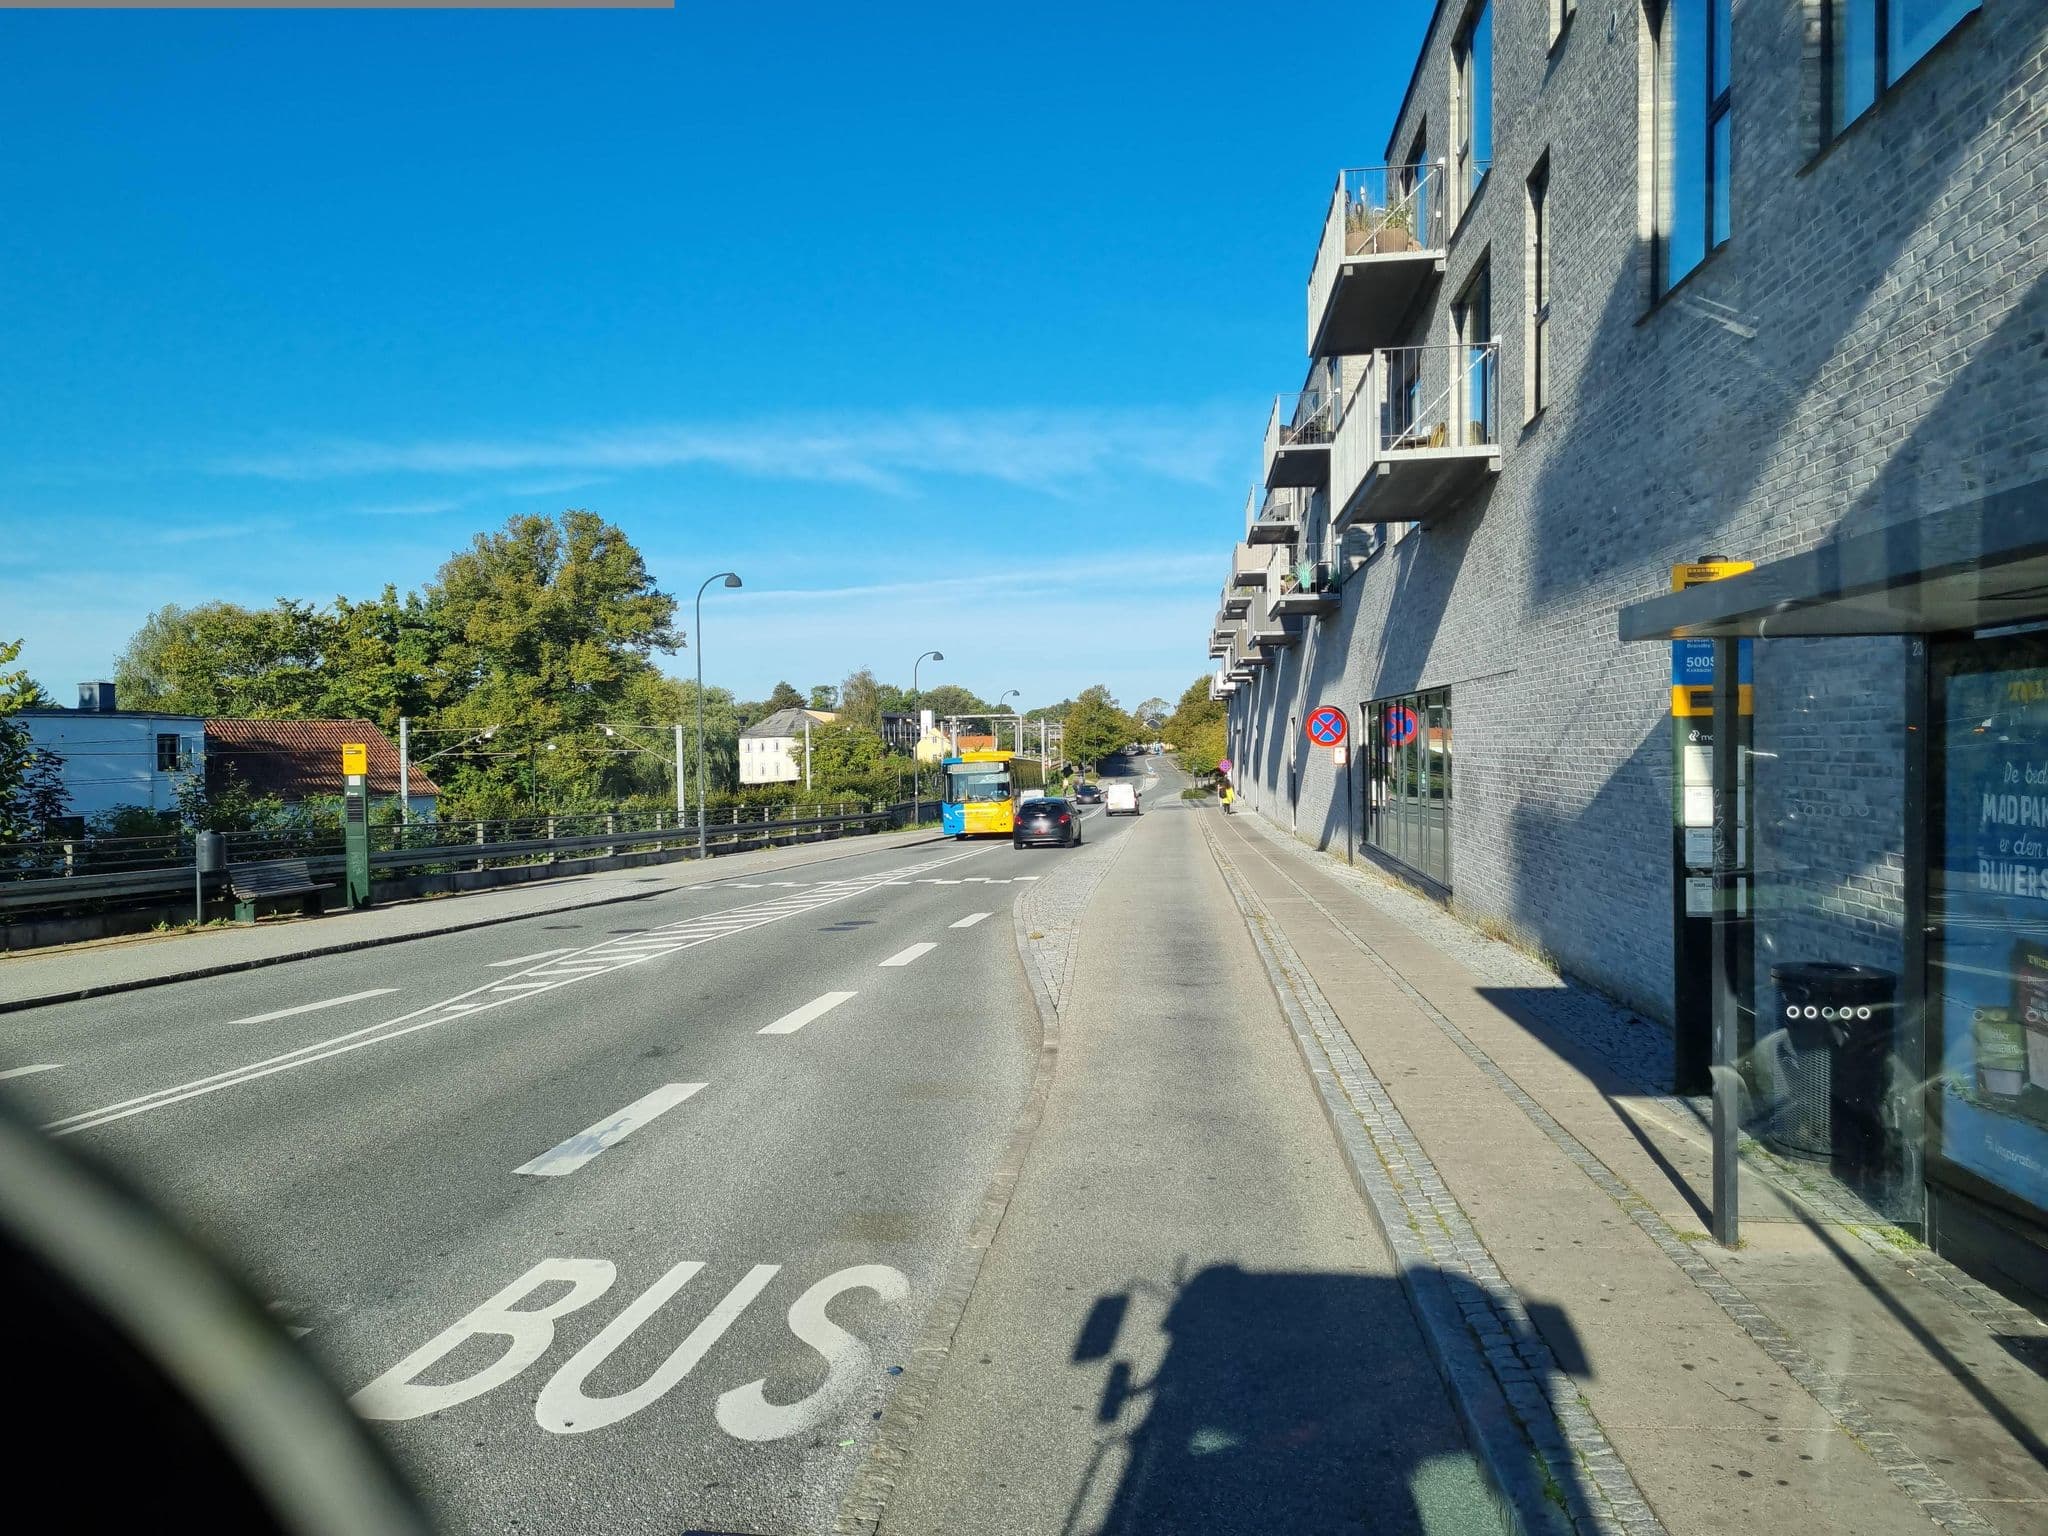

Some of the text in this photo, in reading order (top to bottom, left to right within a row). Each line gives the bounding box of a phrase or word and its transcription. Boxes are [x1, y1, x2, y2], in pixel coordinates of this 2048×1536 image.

[2004, 761, 2019, 783] De
[2013, 832, 2042, 858] dem
[347, 1257, 910, 1441] BUS
